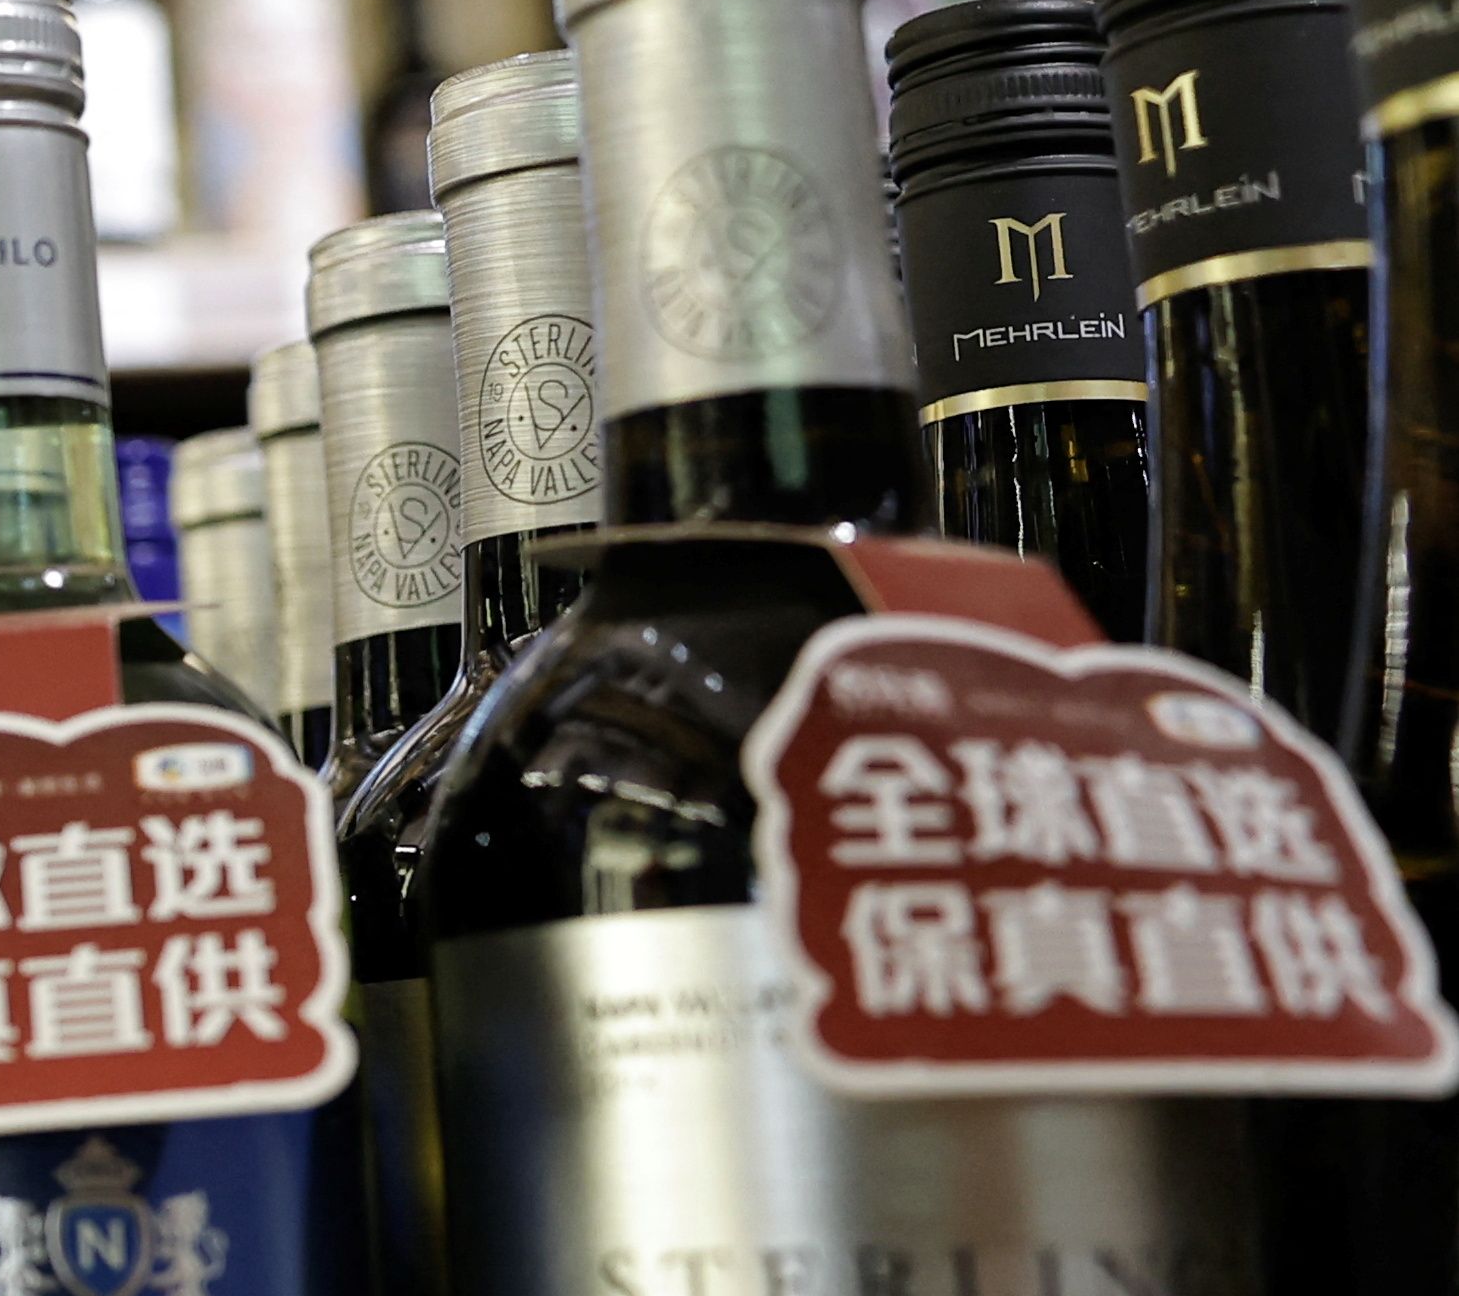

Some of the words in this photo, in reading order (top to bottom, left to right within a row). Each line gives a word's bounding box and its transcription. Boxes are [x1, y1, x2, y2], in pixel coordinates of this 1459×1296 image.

[988, 212, 1074, 302] M
[530, 432, 604, 496] VALLE
[818, 734, 1342, 884] 全球直选
[841, 880, 1394, 1022] 保真直供
